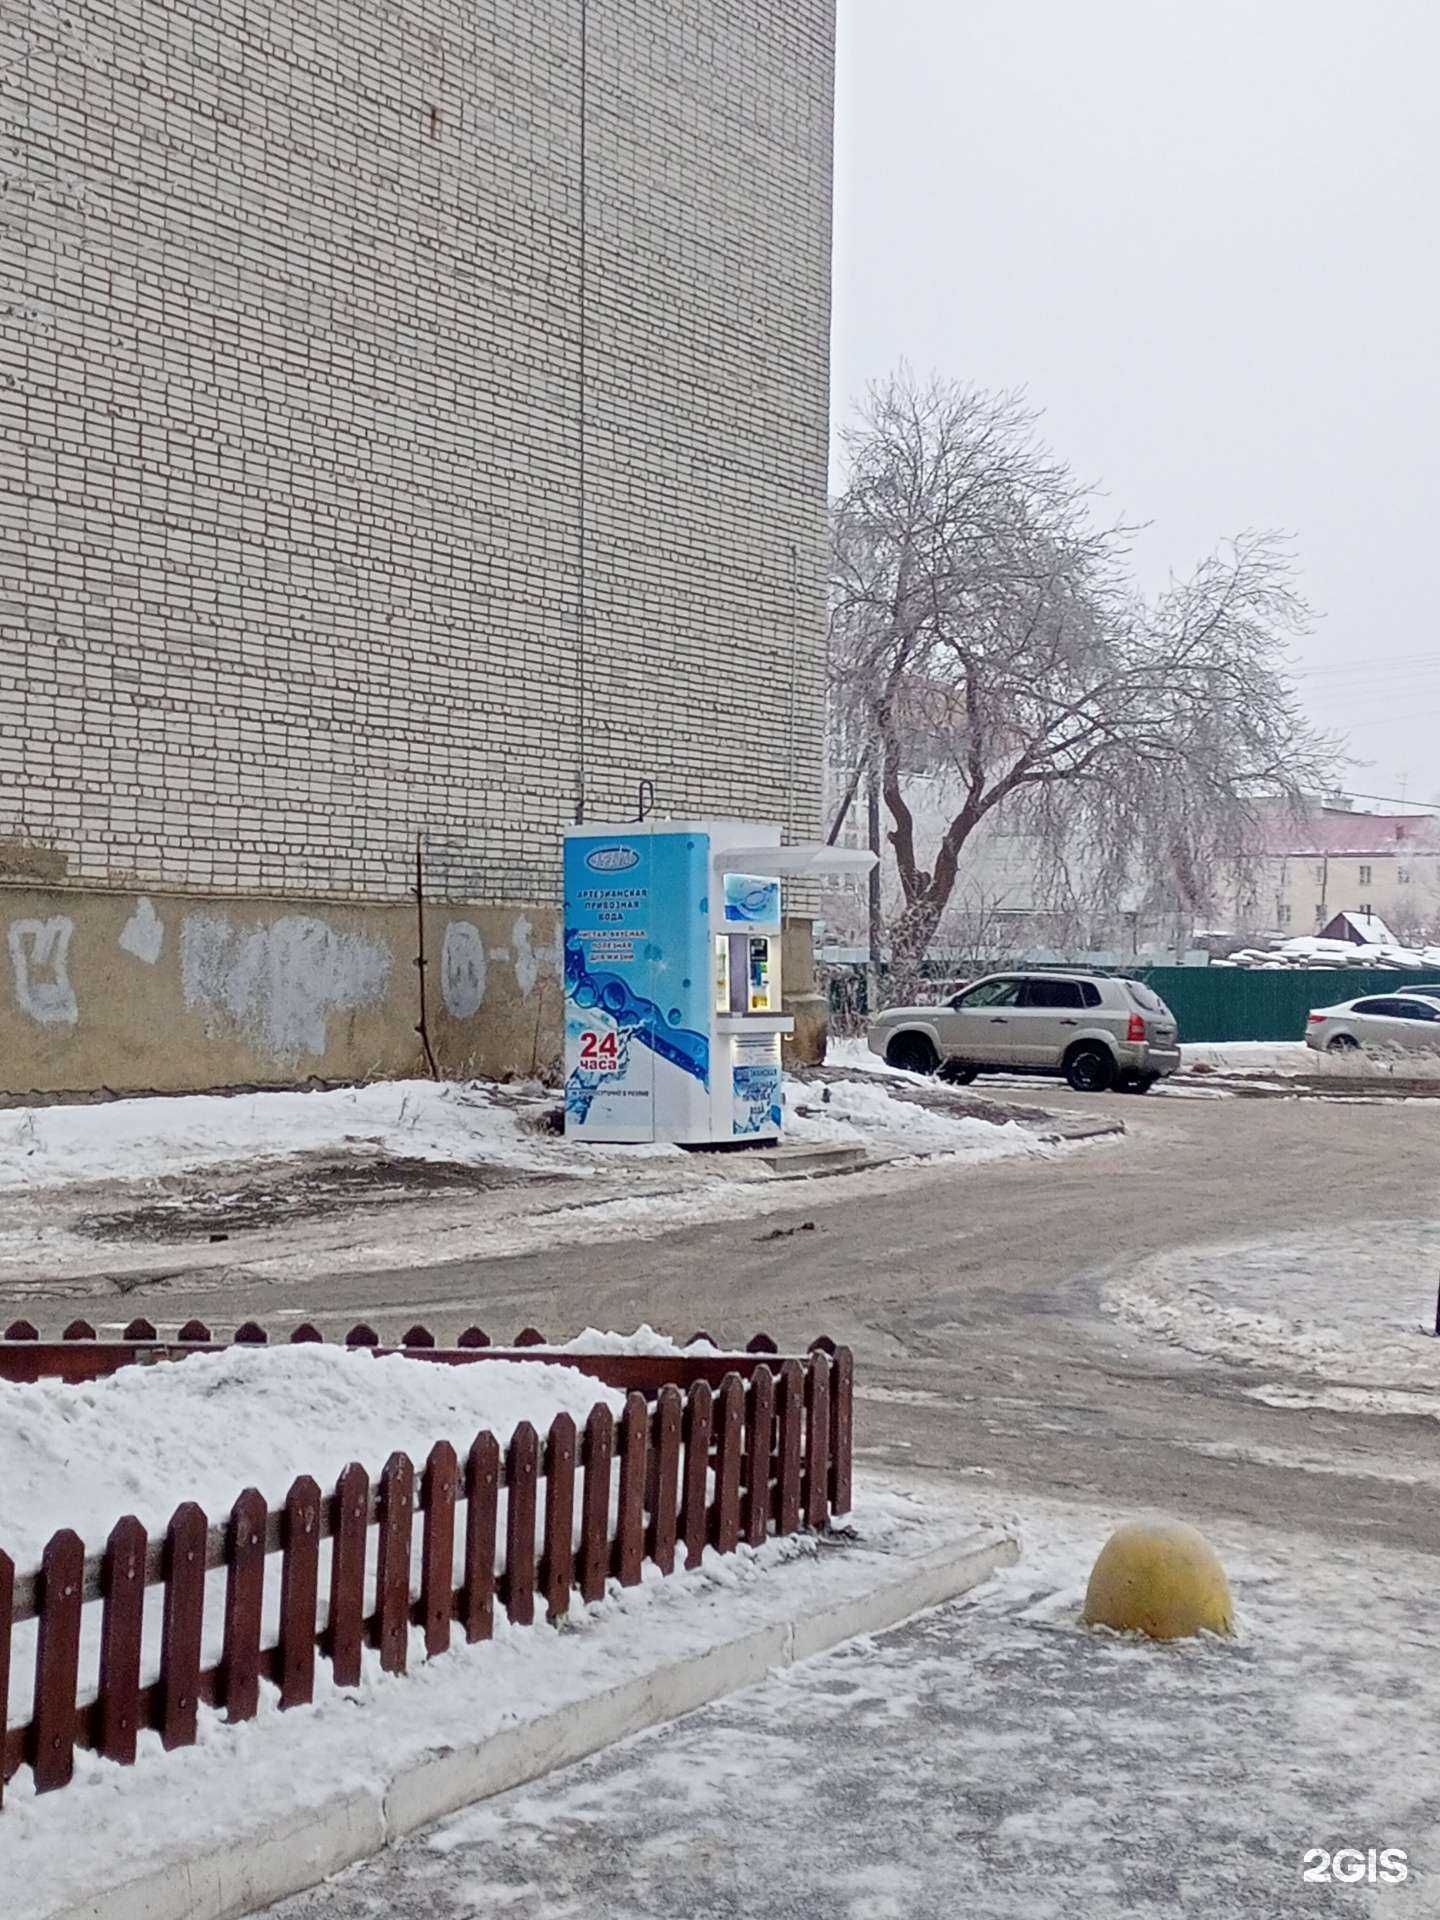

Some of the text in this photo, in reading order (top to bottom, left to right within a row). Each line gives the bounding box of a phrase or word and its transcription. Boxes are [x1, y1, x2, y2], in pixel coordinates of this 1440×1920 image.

[577, 889, 647, 898] АРТЕЗИАНСКАЯ
[585, 901, 639, 909] ПРИВОЗНАЯ
[580, 1032, 618, 1057] 24
[580, 1060, 617, 1070] часа
